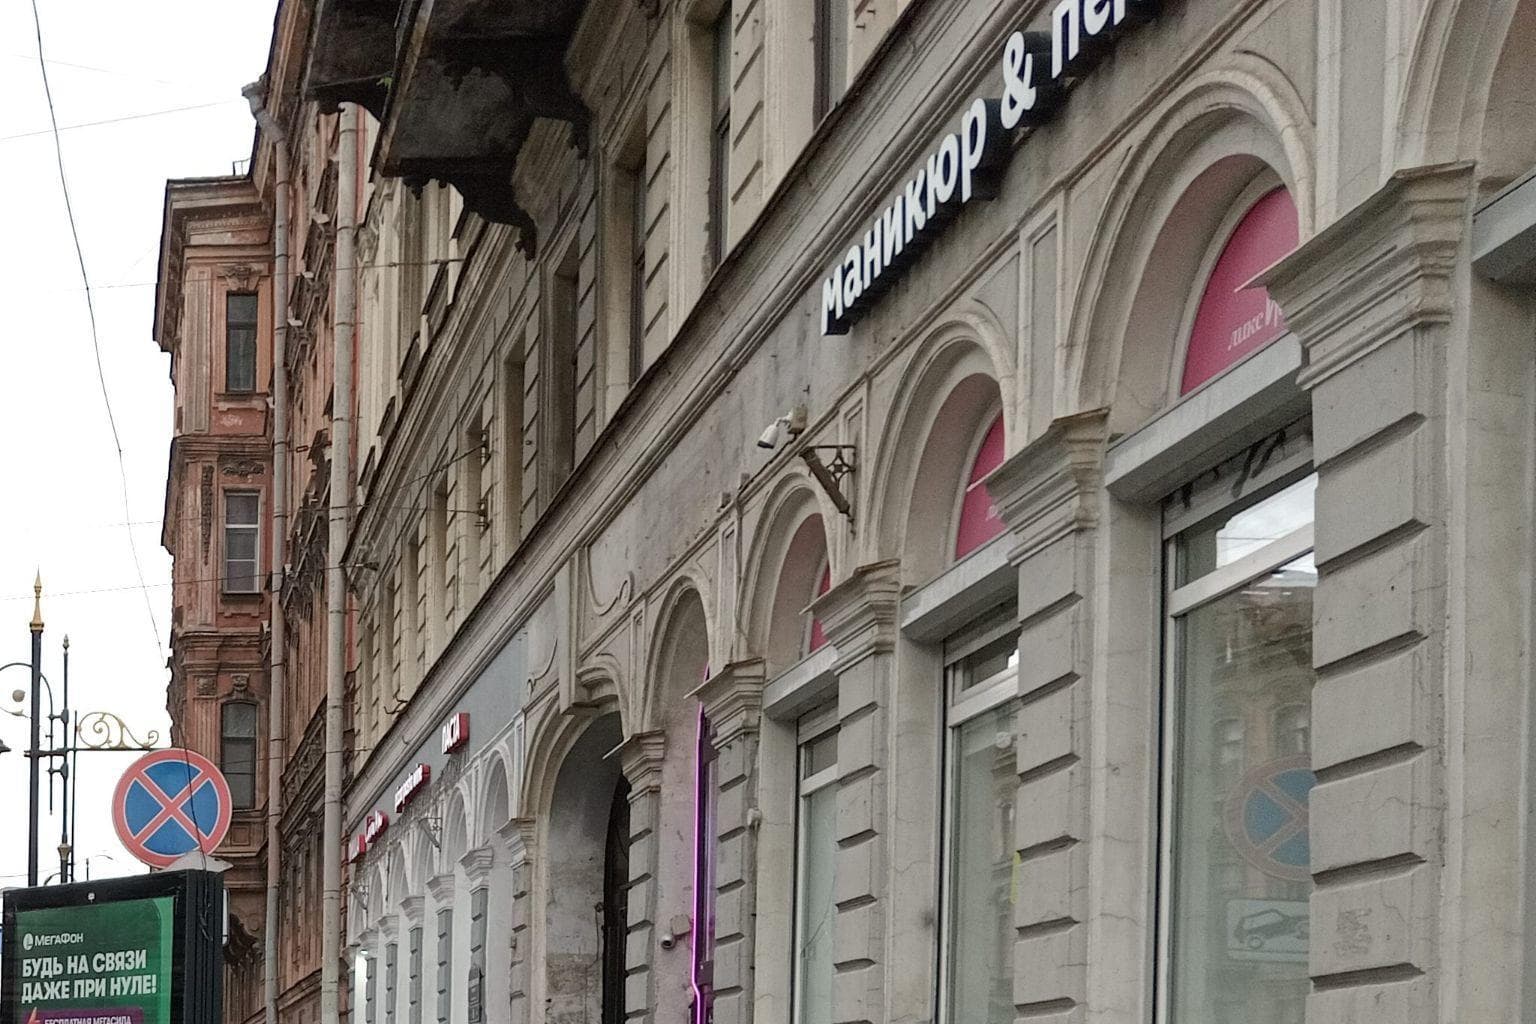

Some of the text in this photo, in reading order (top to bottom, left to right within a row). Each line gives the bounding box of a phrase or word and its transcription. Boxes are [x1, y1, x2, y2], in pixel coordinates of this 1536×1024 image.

[1000, 31, 1037, 130] &
[22, 949, 147, 979] БУДЬ НА СВЯЗИ
[21, 974, 157, 1004] ДАЖЕ ПРИ НУЛЕ!
